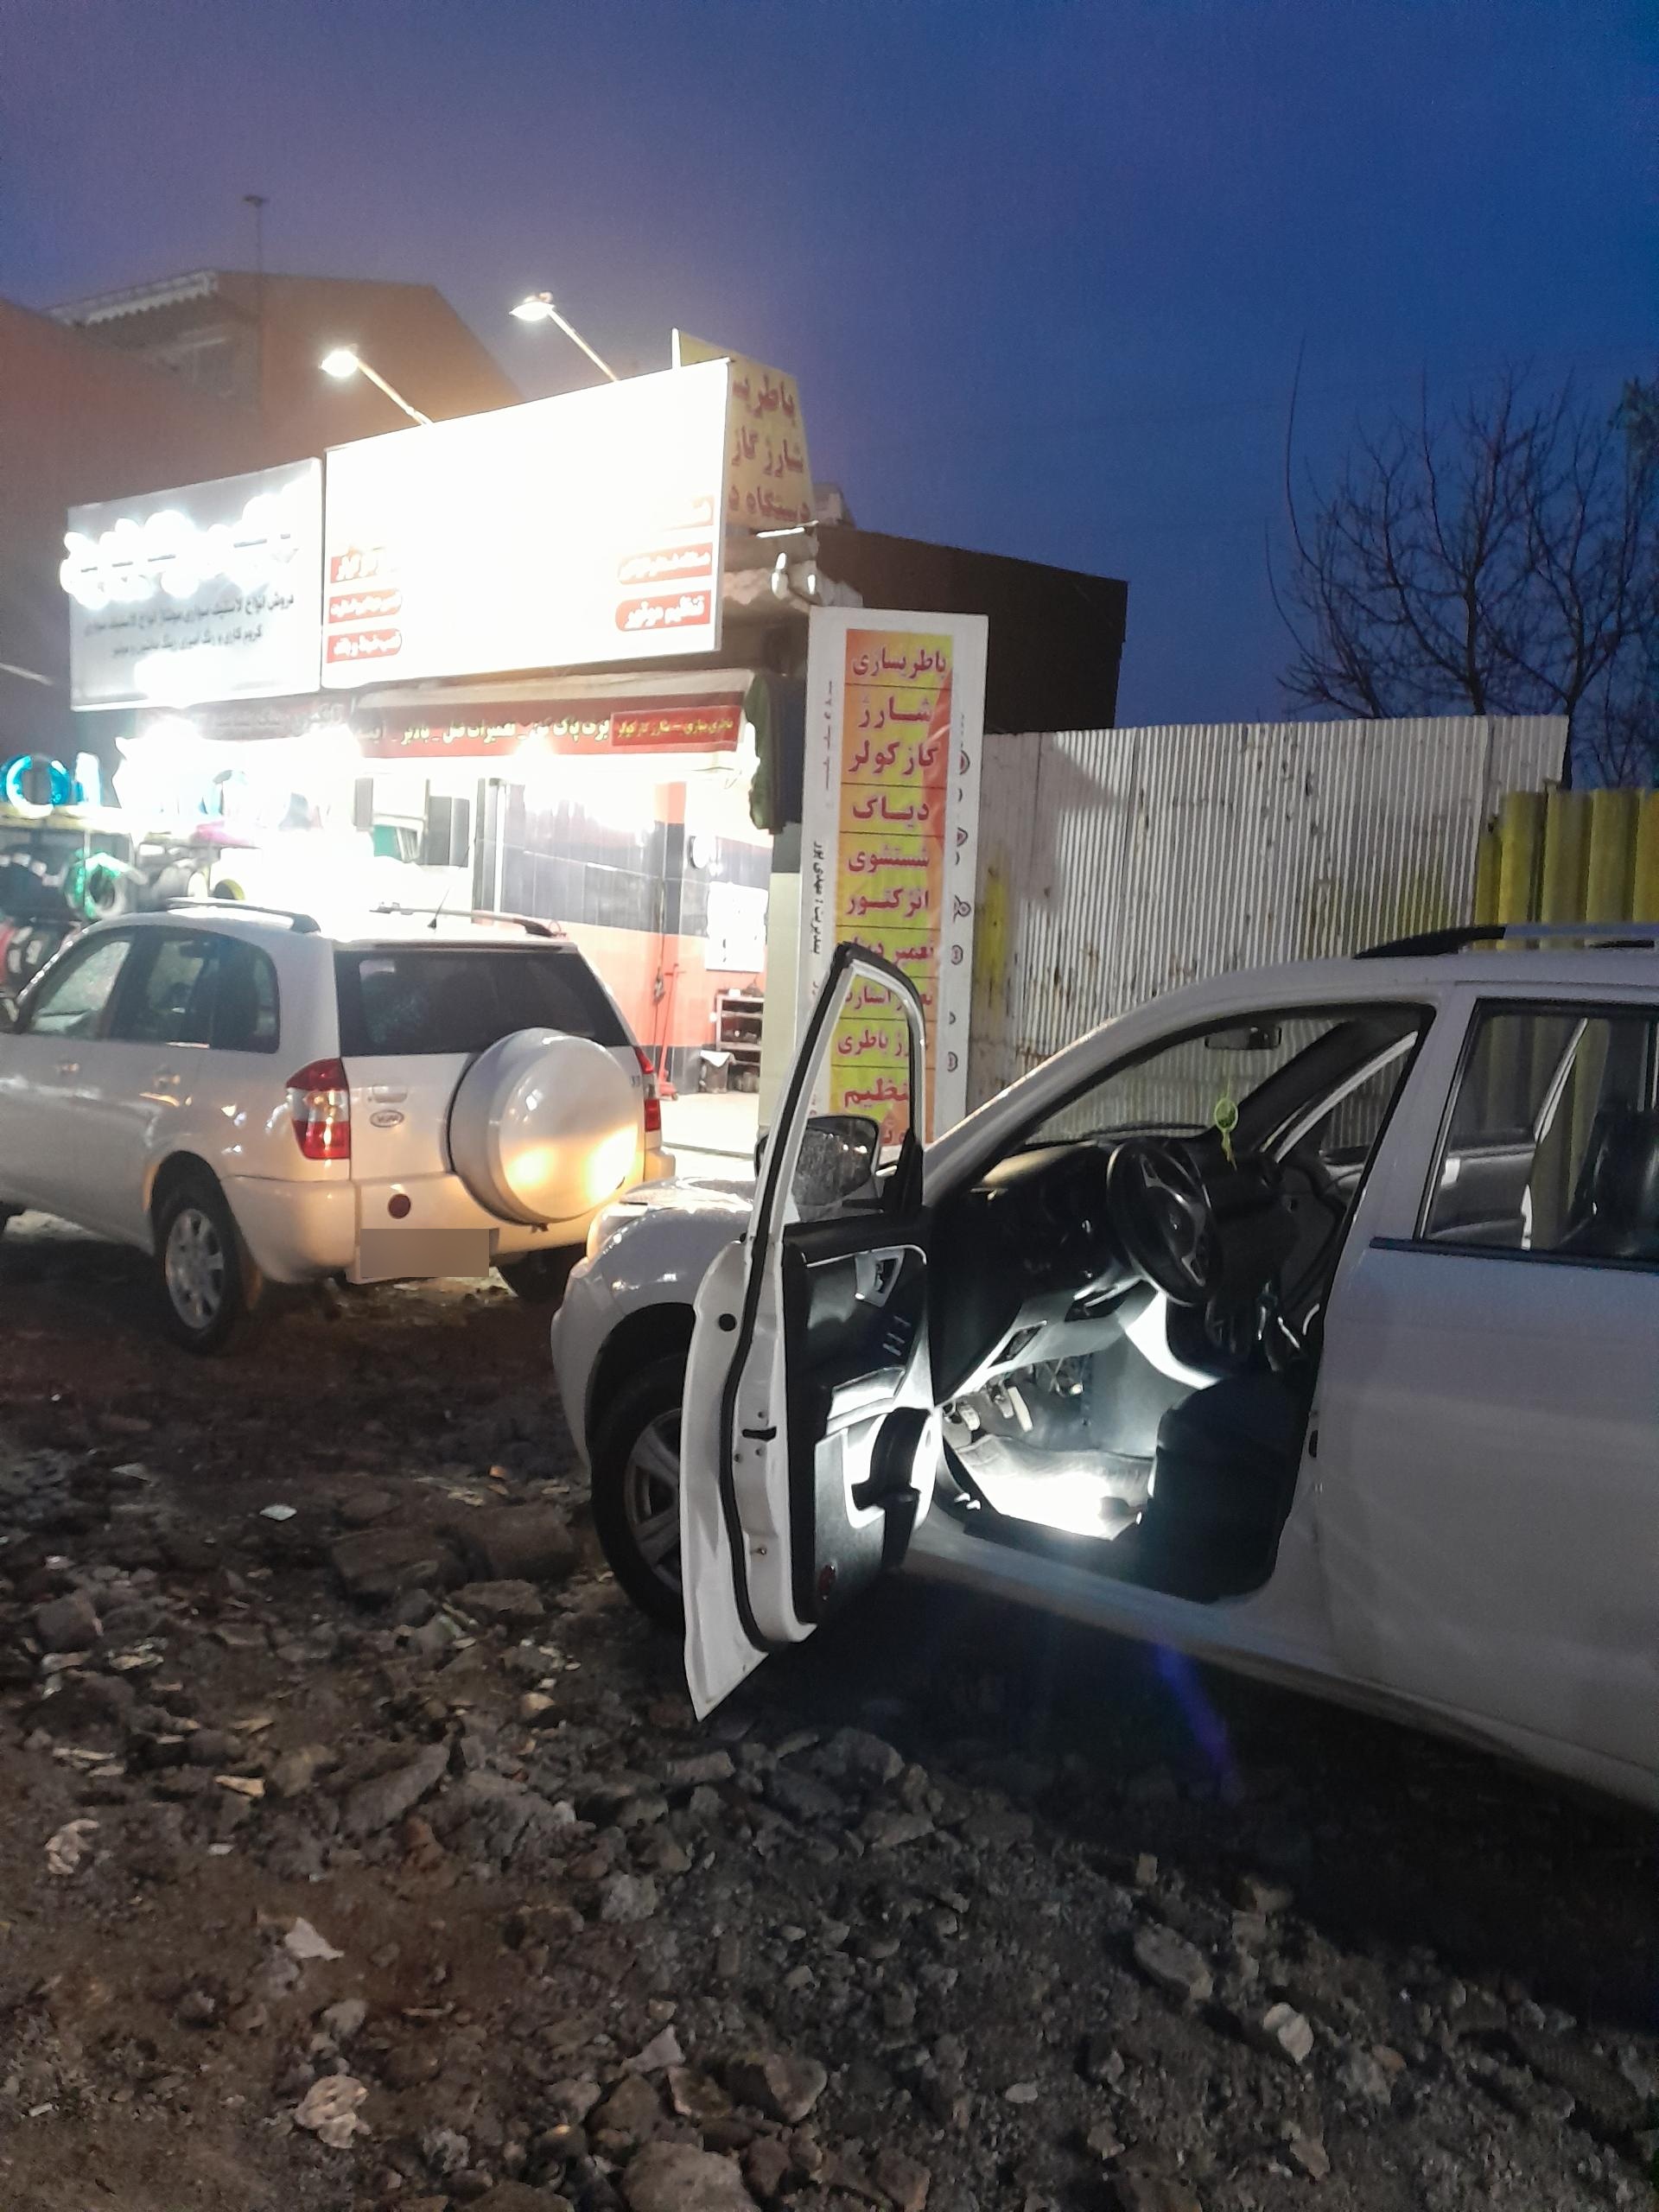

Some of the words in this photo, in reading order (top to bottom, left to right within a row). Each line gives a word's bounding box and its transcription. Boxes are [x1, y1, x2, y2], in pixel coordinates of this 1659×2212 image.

[858, 696, 931, 728] شارژ
[848, 740, 900, 773] کولر
[838, 1029, 889, 1056] باطری
[844, 1077, 910, 1109] نظیم
